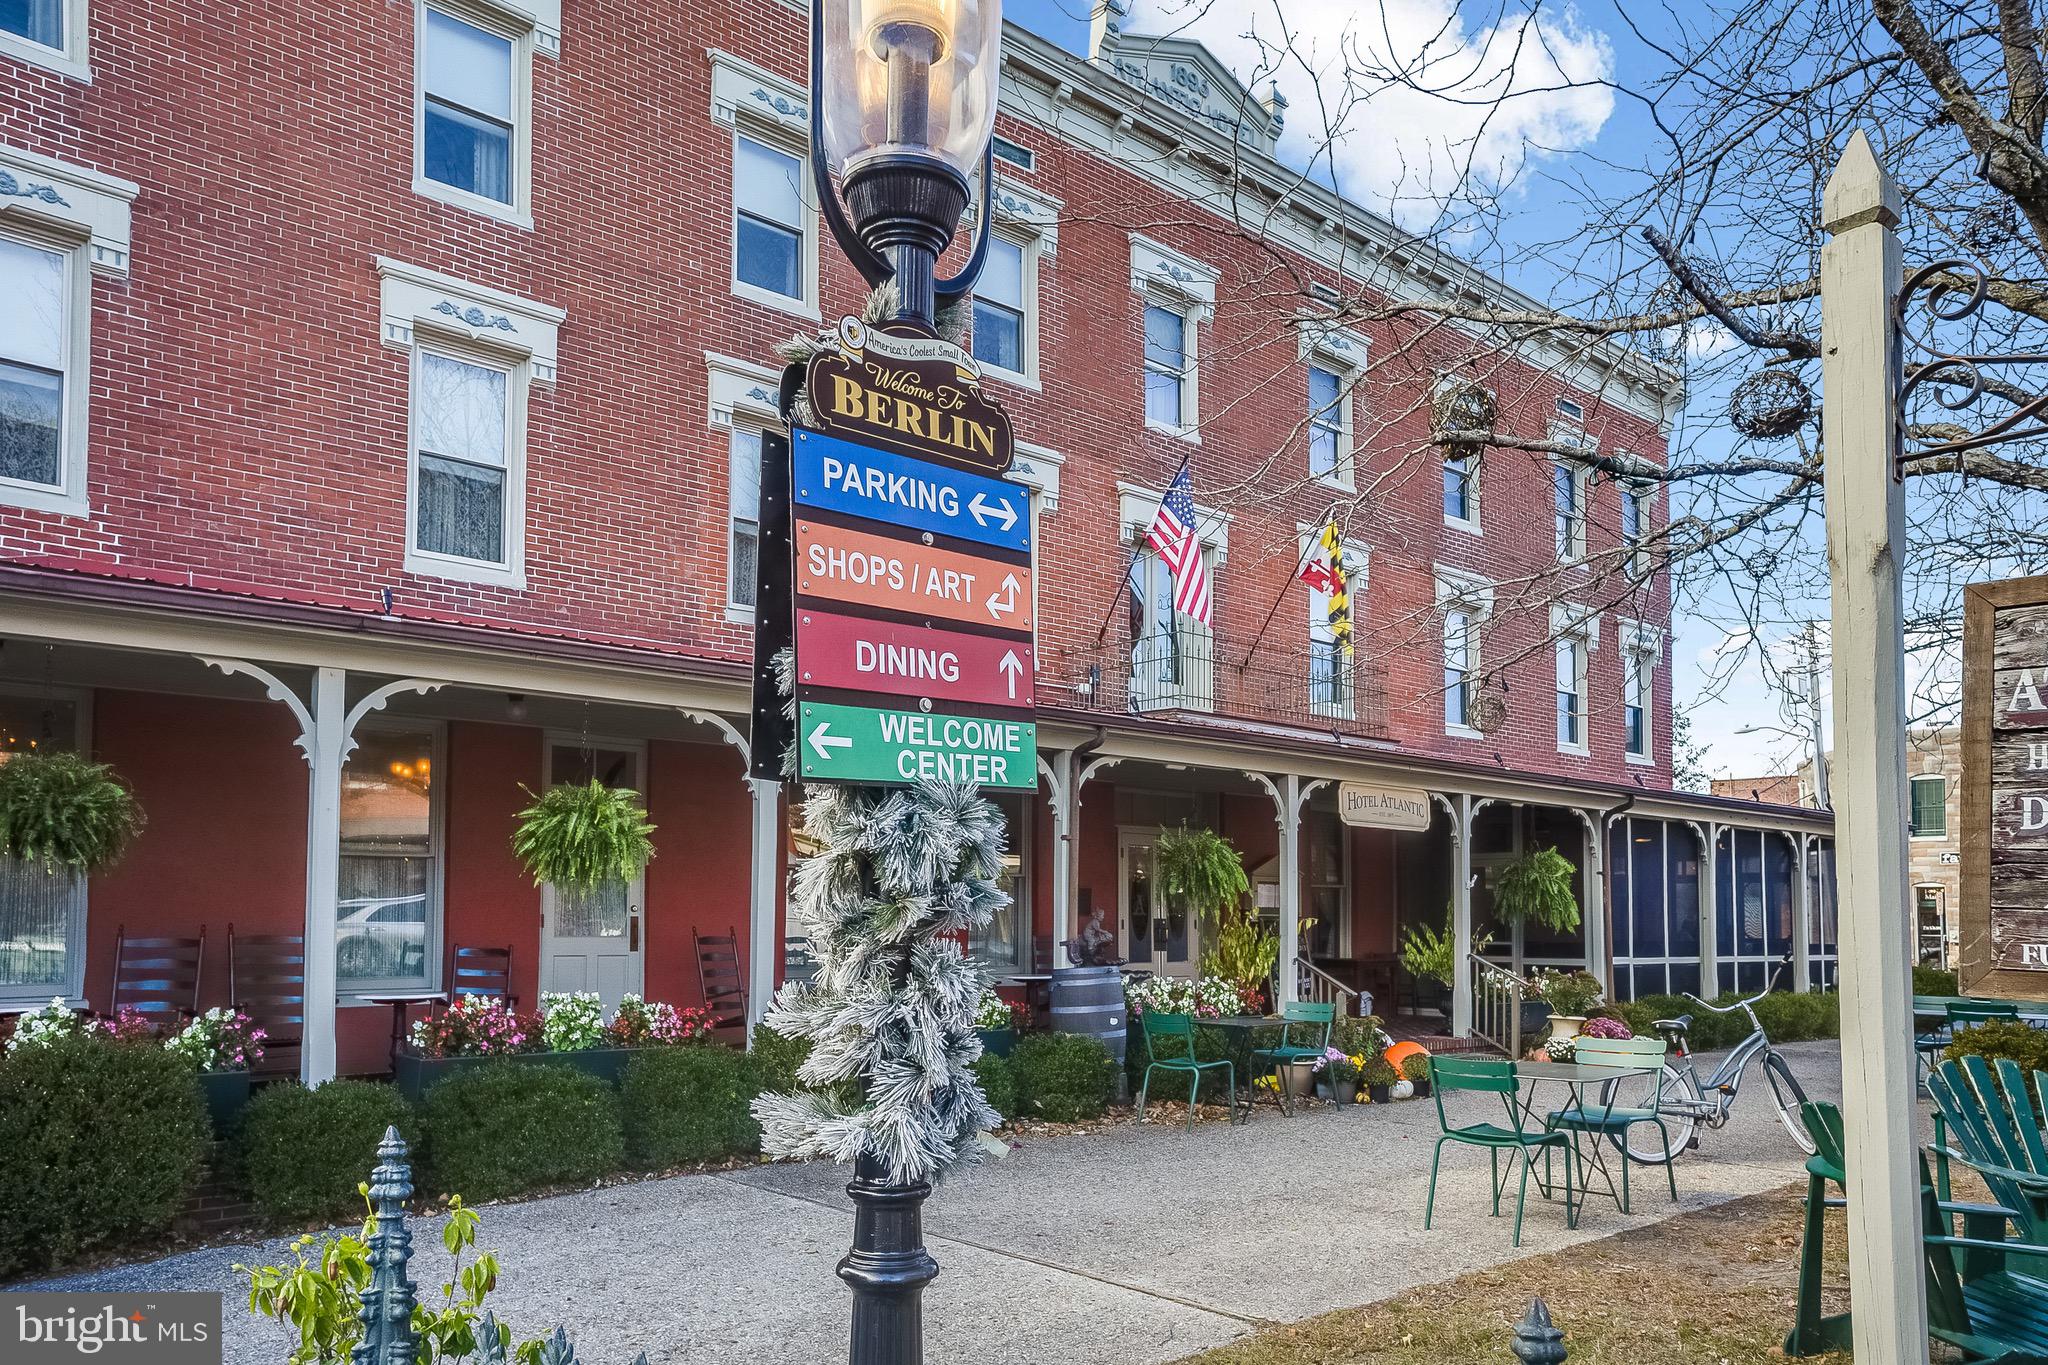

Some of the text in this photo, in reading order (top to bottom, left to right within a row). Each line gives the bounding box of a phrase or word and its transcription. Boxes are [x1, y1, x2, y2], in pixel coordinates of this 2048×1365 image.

[868, 331, 908, 356] America's
[909, 344, 936, 357] Coolest
[938, 344, 959, 361] Small
[960, 351, 977, 373] Town
[865, 362, 968, 411] Welcome To
[830, 374, 998, 457] BERLIN
[823, 457, 960, 517] PARKING
[807, 544, 976, 603] SHOPS / ART
[856, 640, 960, 682] DINING
[879, 713, 1021, 753] WELCOME
[897, 749, 1008, 784] CENTER
[1347, 791, 1425, 818] HOTEL ATLANTIC
